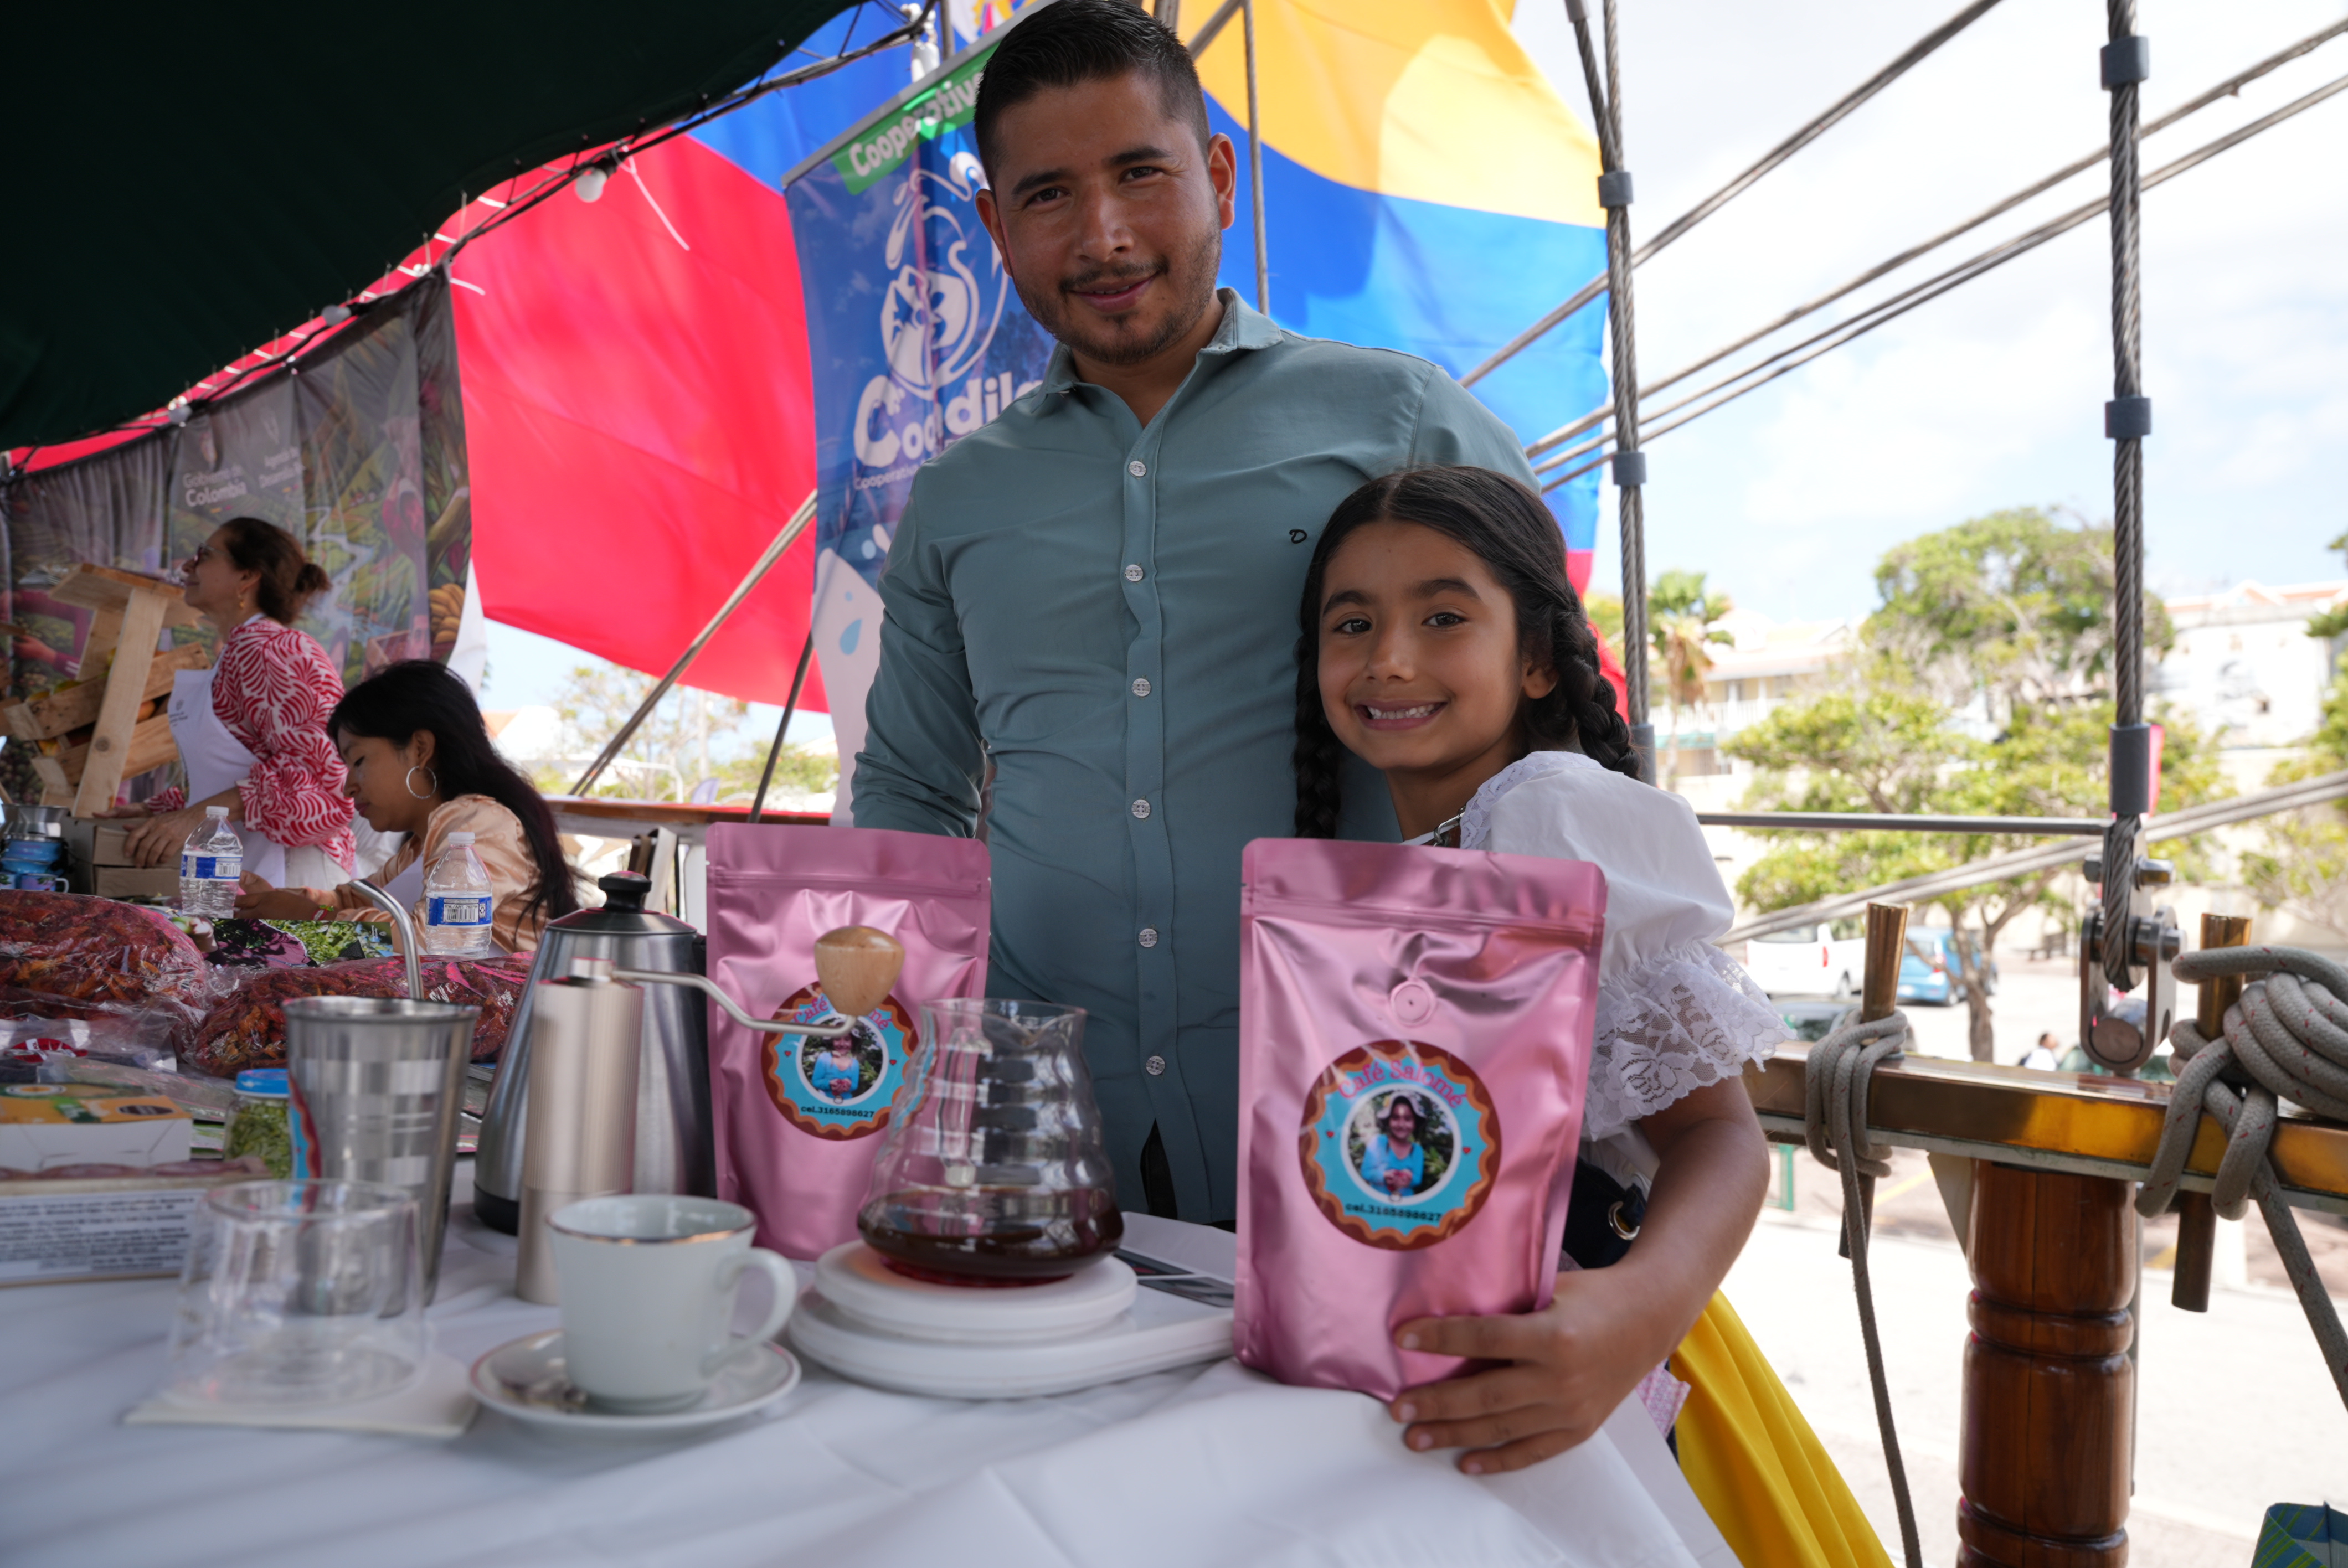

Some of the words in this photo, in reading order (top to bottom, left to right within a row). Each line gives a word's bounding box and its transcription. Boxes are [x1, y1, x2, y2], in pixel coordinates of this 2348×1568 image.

[854, 371, 1042, 467] Coodil
[186, 478, 248, 507] Colombia
[794, 995, 829, 1024] Café
[1339, 1061, 1386, 1100] Café
[1389, 1060, 1468, 1108] Salomé
